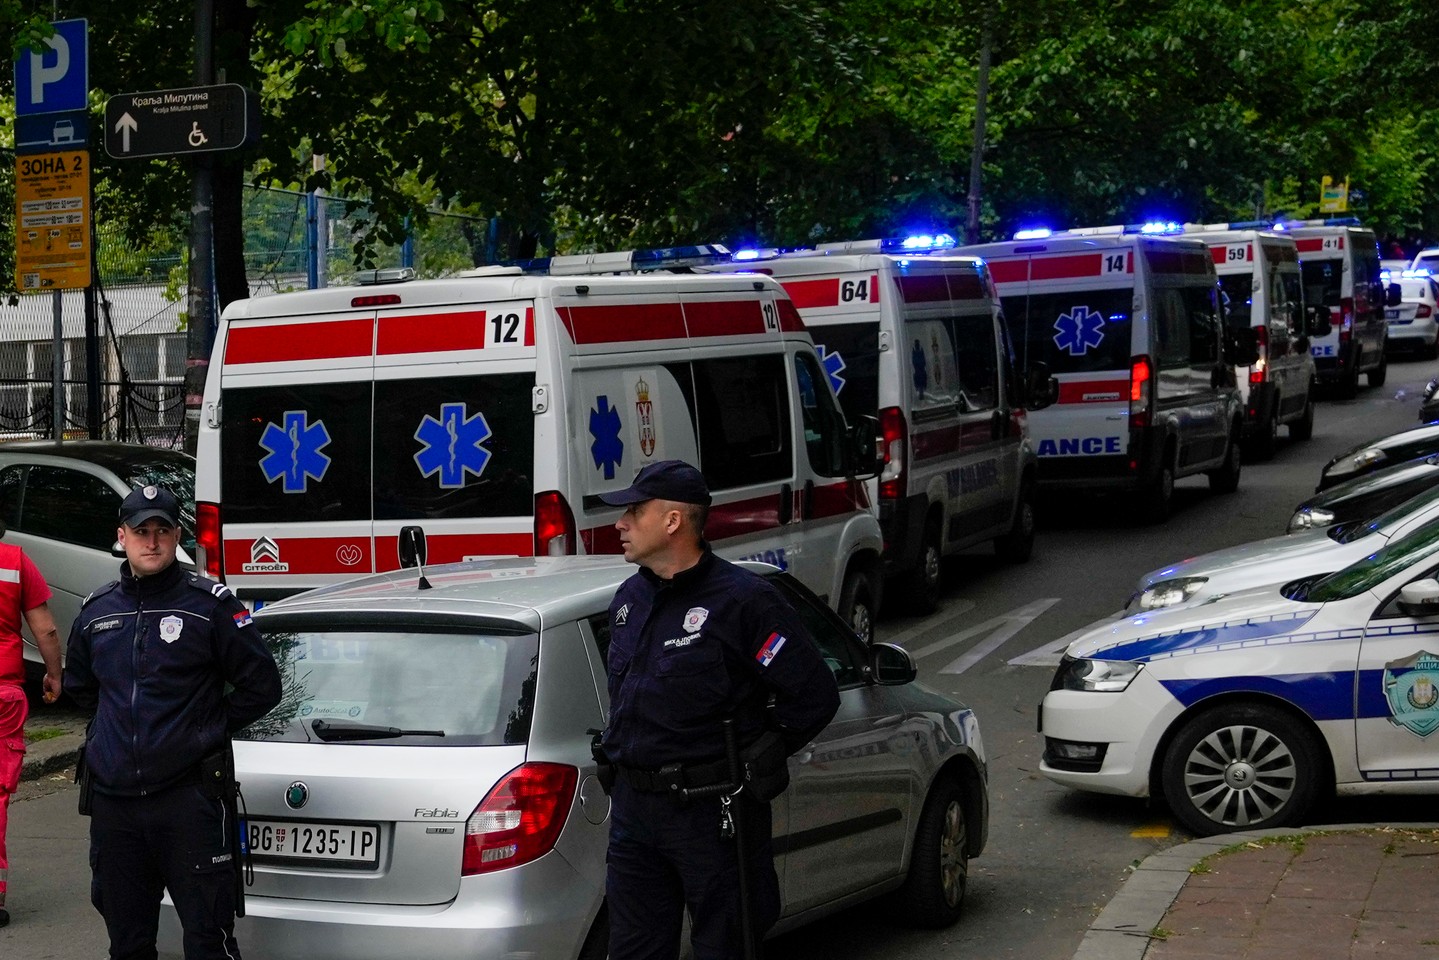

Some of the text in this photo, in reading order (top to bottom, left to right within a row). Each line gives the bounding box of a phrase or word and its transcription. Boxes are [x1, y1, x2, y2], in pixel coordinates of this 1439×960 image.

[132, 91, 209, 108] Краља Милутина
[21, 155, 83, 176] ЗОНА 2
[1324, 236, 1338, 248] 41
[1105, 254, 1124, 272] 14
[1228, 247, 1245, 260] 59
[841, 279, 868, 302] 64
[763, 303, 776, 329] 12
[490, 313, 520, 343] 12
[414, 808, 459, 818] Fabia
[249, 825, 272, 851] BG
